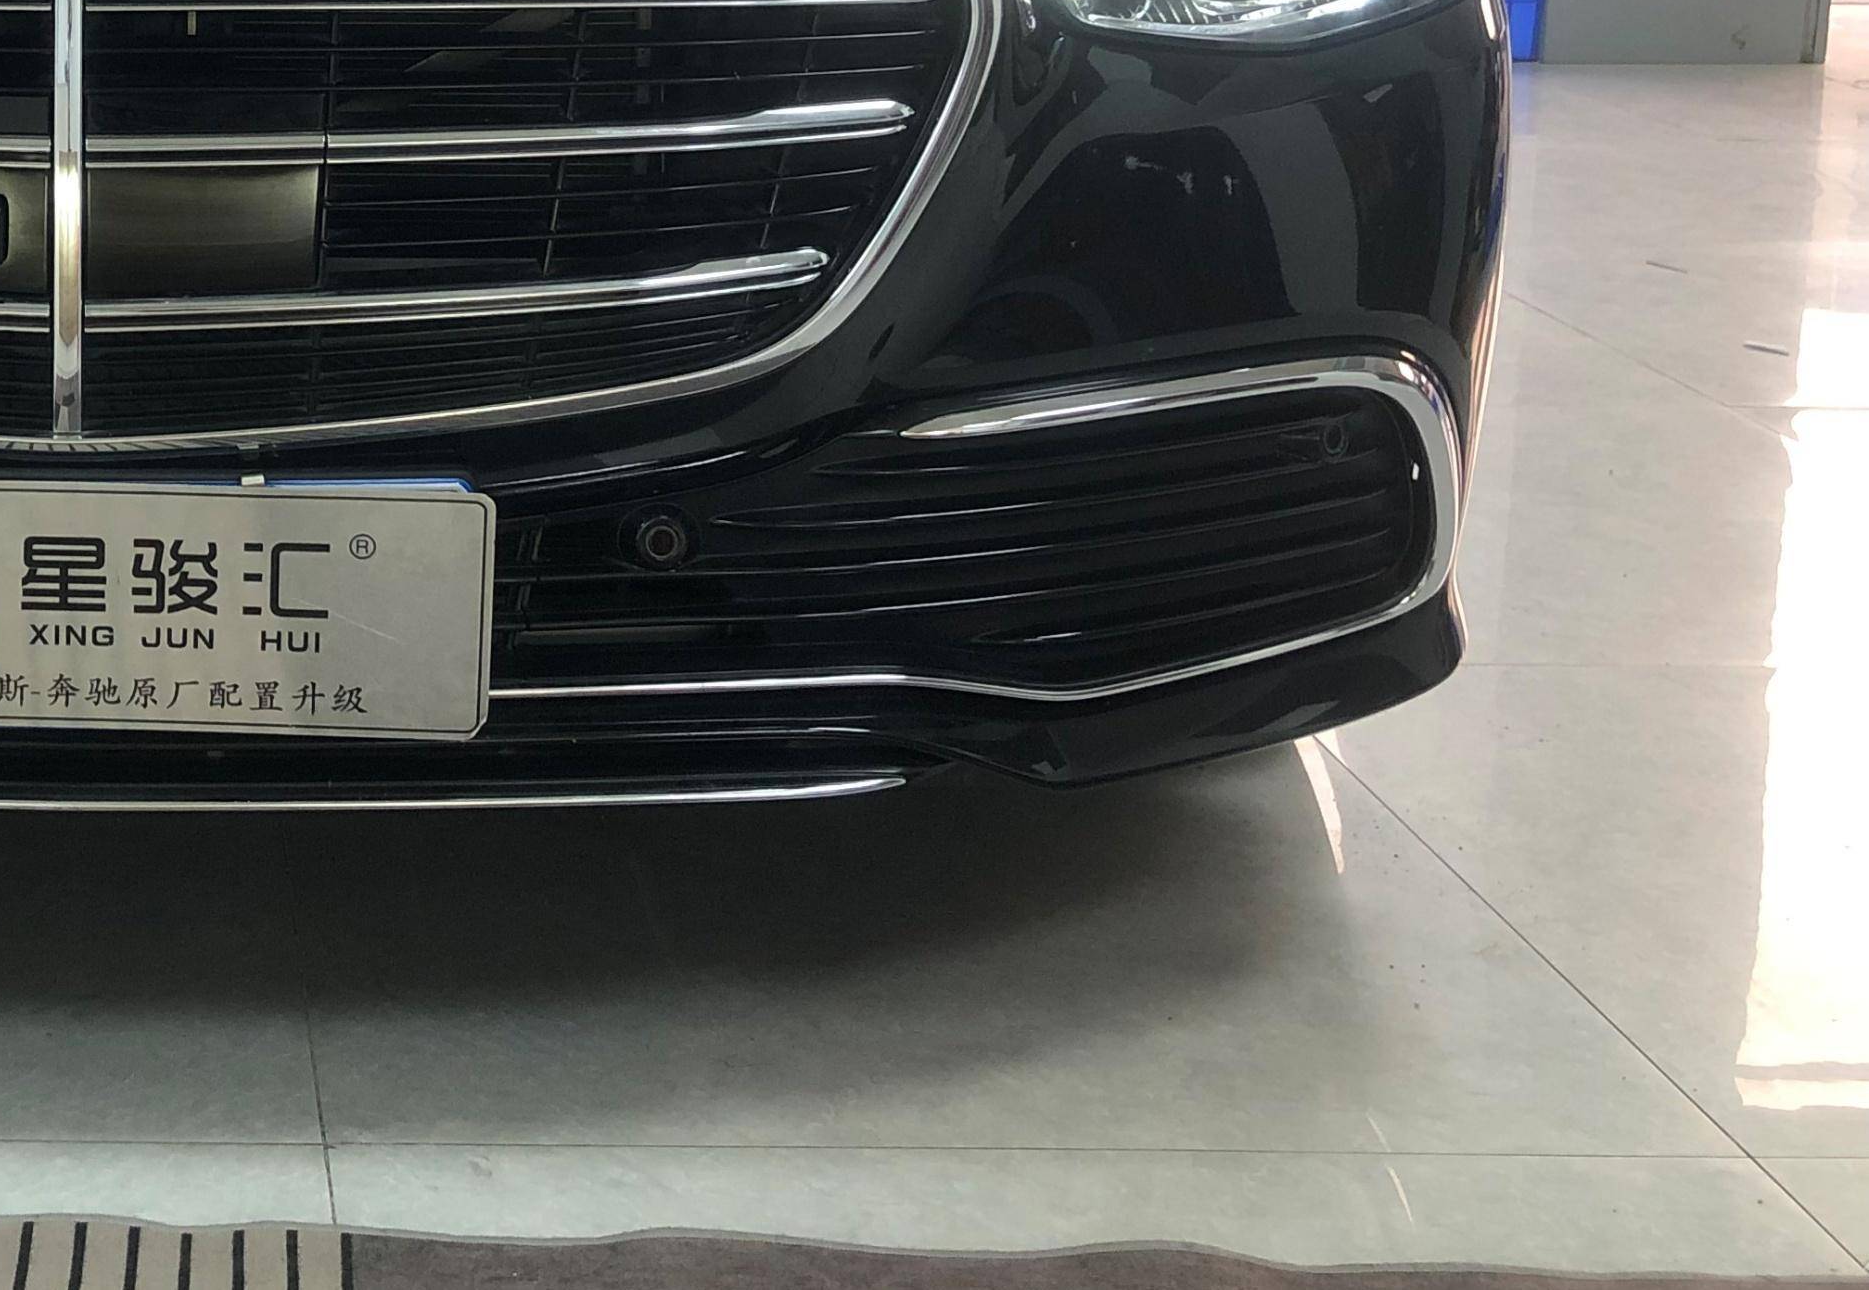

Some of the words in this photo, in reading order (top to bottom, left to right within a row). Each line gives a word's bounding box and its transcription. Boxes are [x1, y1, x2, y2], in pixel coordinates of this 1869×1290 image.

[20, 535, 330, 619] 星骏汇
[29, 623, 116, 648] XING
[141, 627, 215, 651] JUN
[260, 630, 322, 654] HUI
